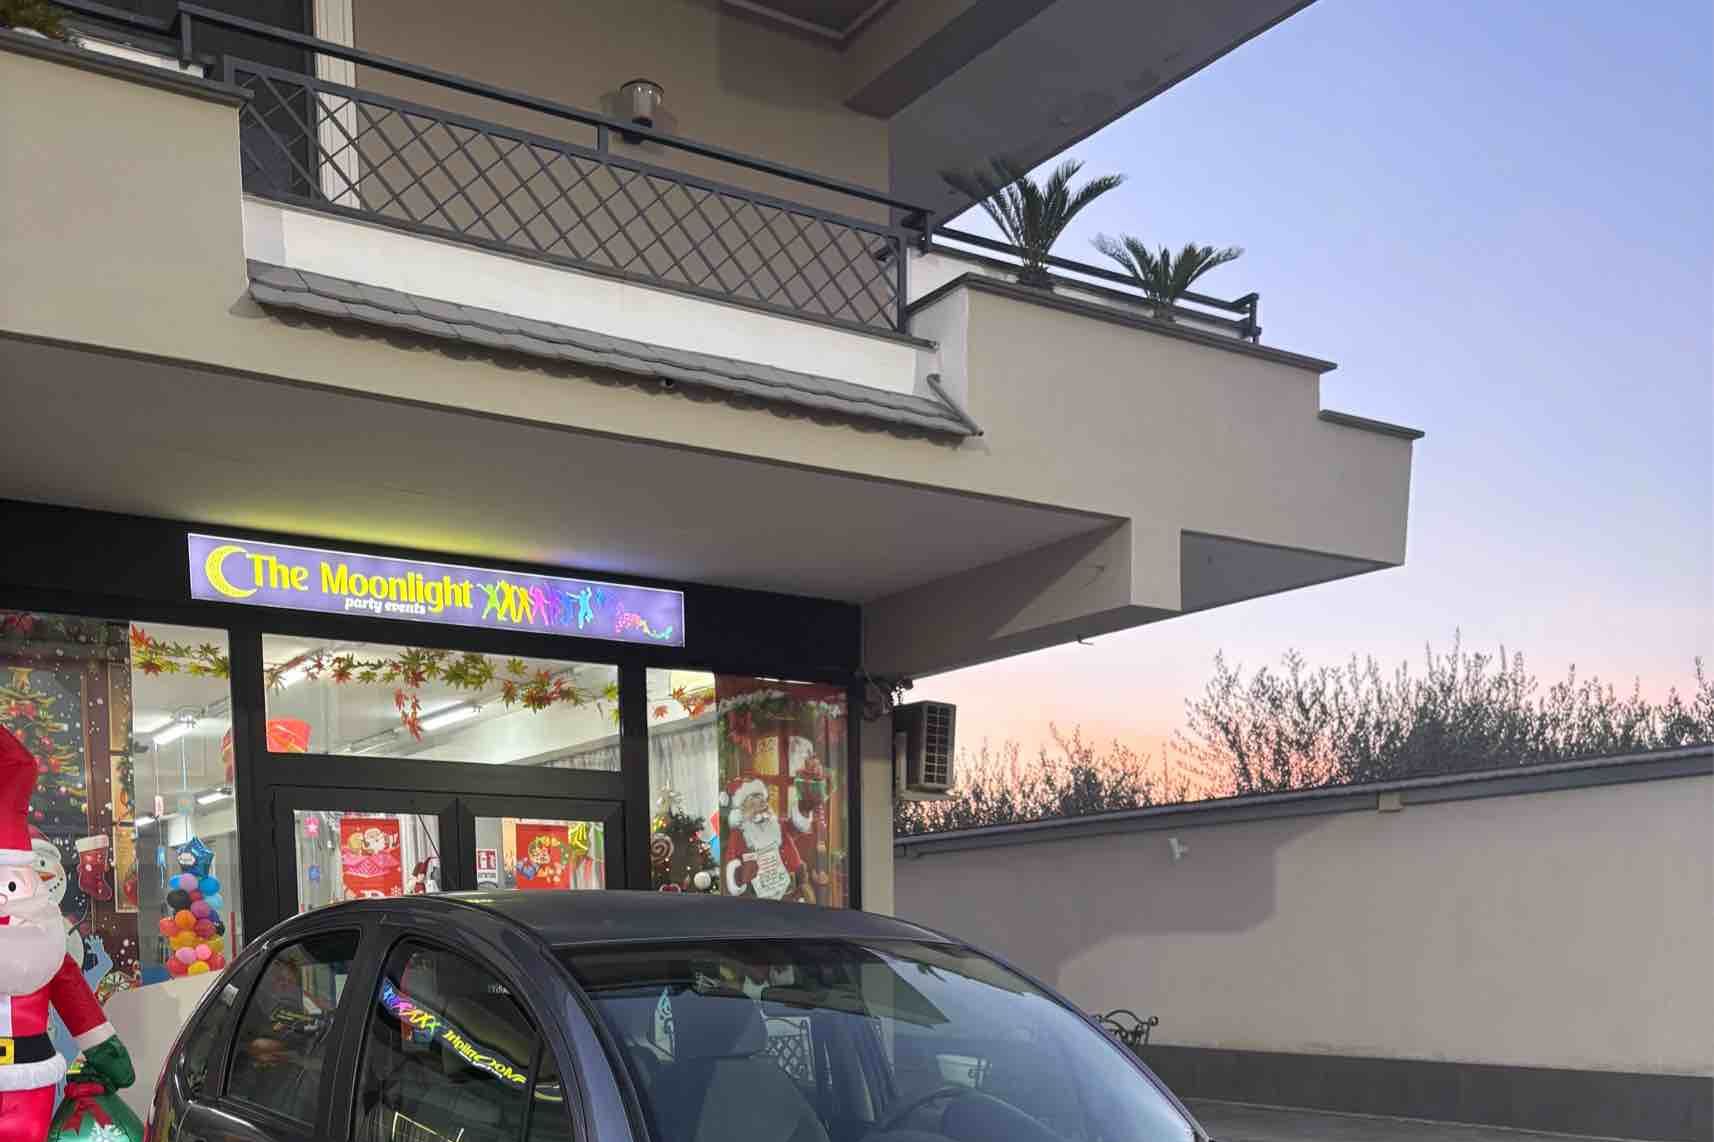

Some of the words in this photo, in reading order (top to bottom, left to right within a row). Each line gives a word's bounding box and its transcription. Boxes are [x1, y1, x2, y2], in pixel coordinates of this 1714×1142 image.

[246, 553, 308, 590] The
[320, 561, 474, 613] Moonlight
[344, 597, 382, 613] party
[385, 602, 426, 614] events
